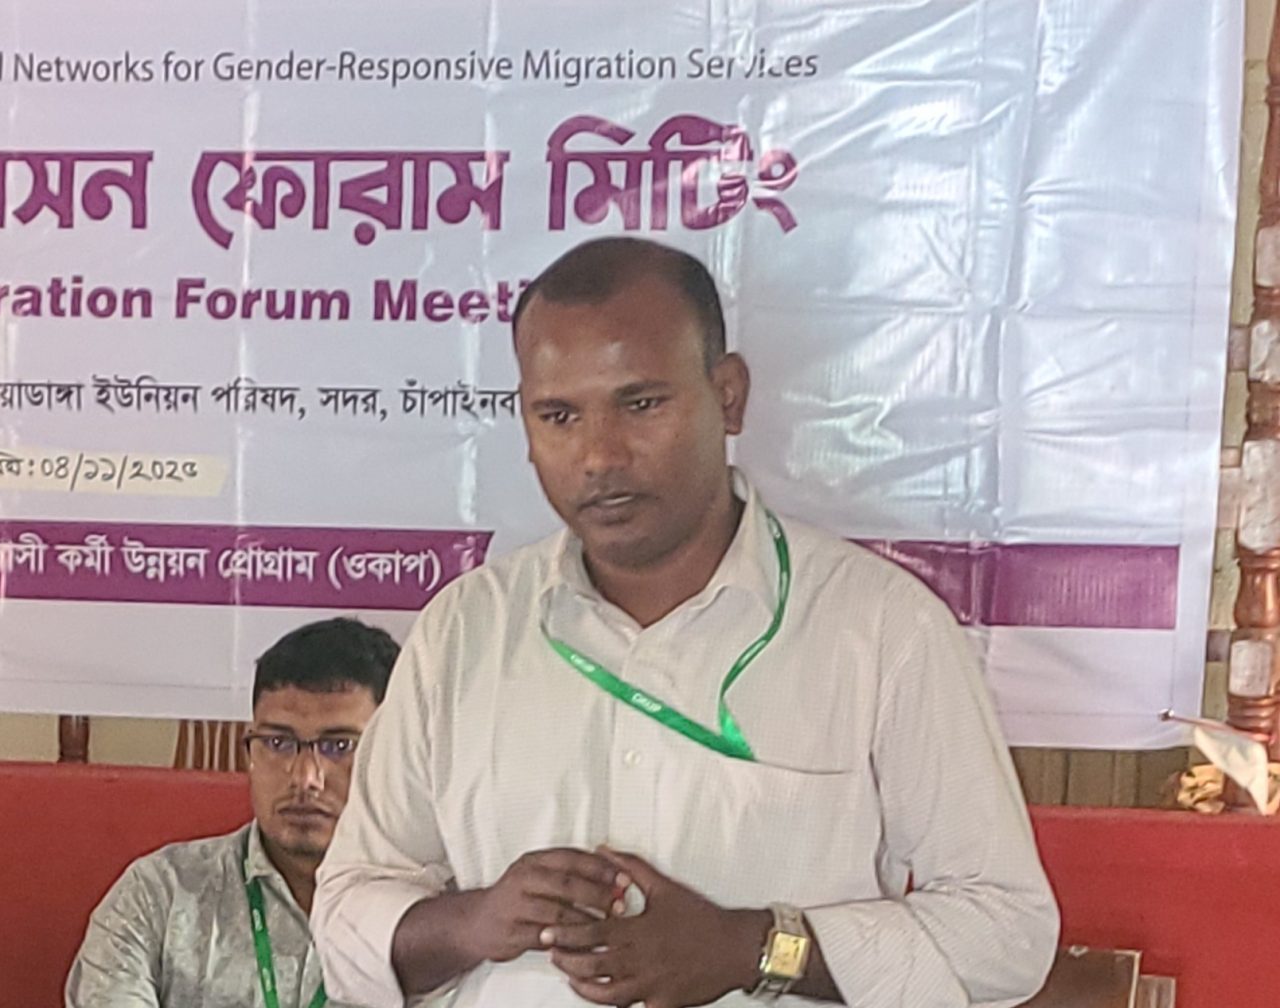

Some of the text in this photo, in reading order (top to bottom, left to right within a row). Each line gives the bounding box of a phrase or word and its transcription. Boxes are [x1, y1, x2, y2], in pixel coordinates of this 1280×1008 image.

[13, 53, 154, 83] Networks
[162, 52, 205, 82] for
[213, 50, 514, 88] Gender-Responsive
[523, 49, 675, 88] Migration
[686, 48, 819, 80] Services
[191, 150, 510, 250] ফোরাম
[545, 114, 798, 235] মিটিং
[175, 278, 351, 321] Forum
[373, 278, 530, 324] Meet
[91, 374, 202, 414] ইউনিয়ন
[210, 376, 306, 421] পরিষদ,
[317, 386, 388, 422] সদর,
[398, 378, 521, 419] চাঁপাইনব
[55, 533, 115, 576] কর্মী
[122, 536, 211, 583] উন্নয়ন
[218, 545, 319, 583] প্রোগ্রাম
[327, 546, 442, 590] (ওকাপ)
